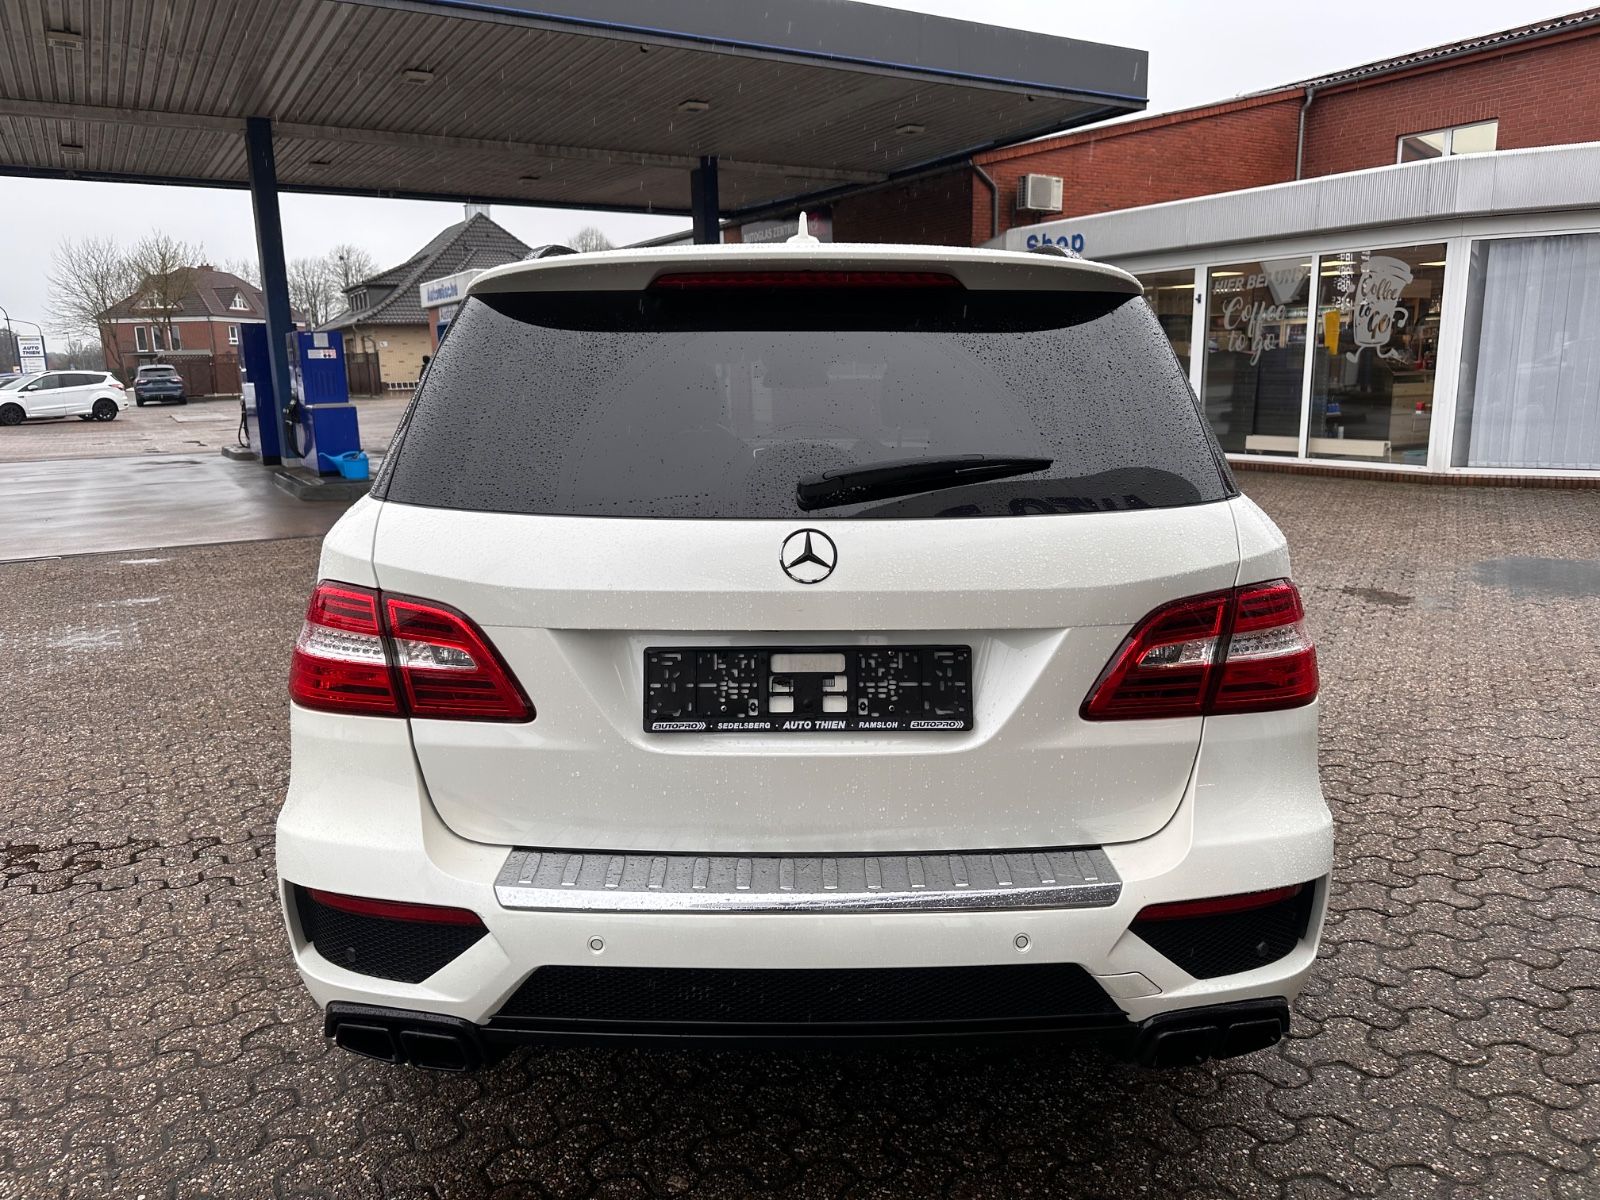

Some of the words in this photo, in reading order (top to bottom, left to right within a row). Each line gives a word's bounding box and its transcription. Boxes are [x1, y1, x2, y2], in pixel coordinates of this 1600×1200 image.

[1222, 296, 1287, 338] Coffee
[1228, 330, 1247, 352] to
[1249, 333, 1280, 366] go
[717, 722, 771, 730] SEDELSBERG
[783, 720, 813, 730] AUTO
[815, 720, 846, 730] THIEN
[858, 721, 899, 729] RAMSLOH
